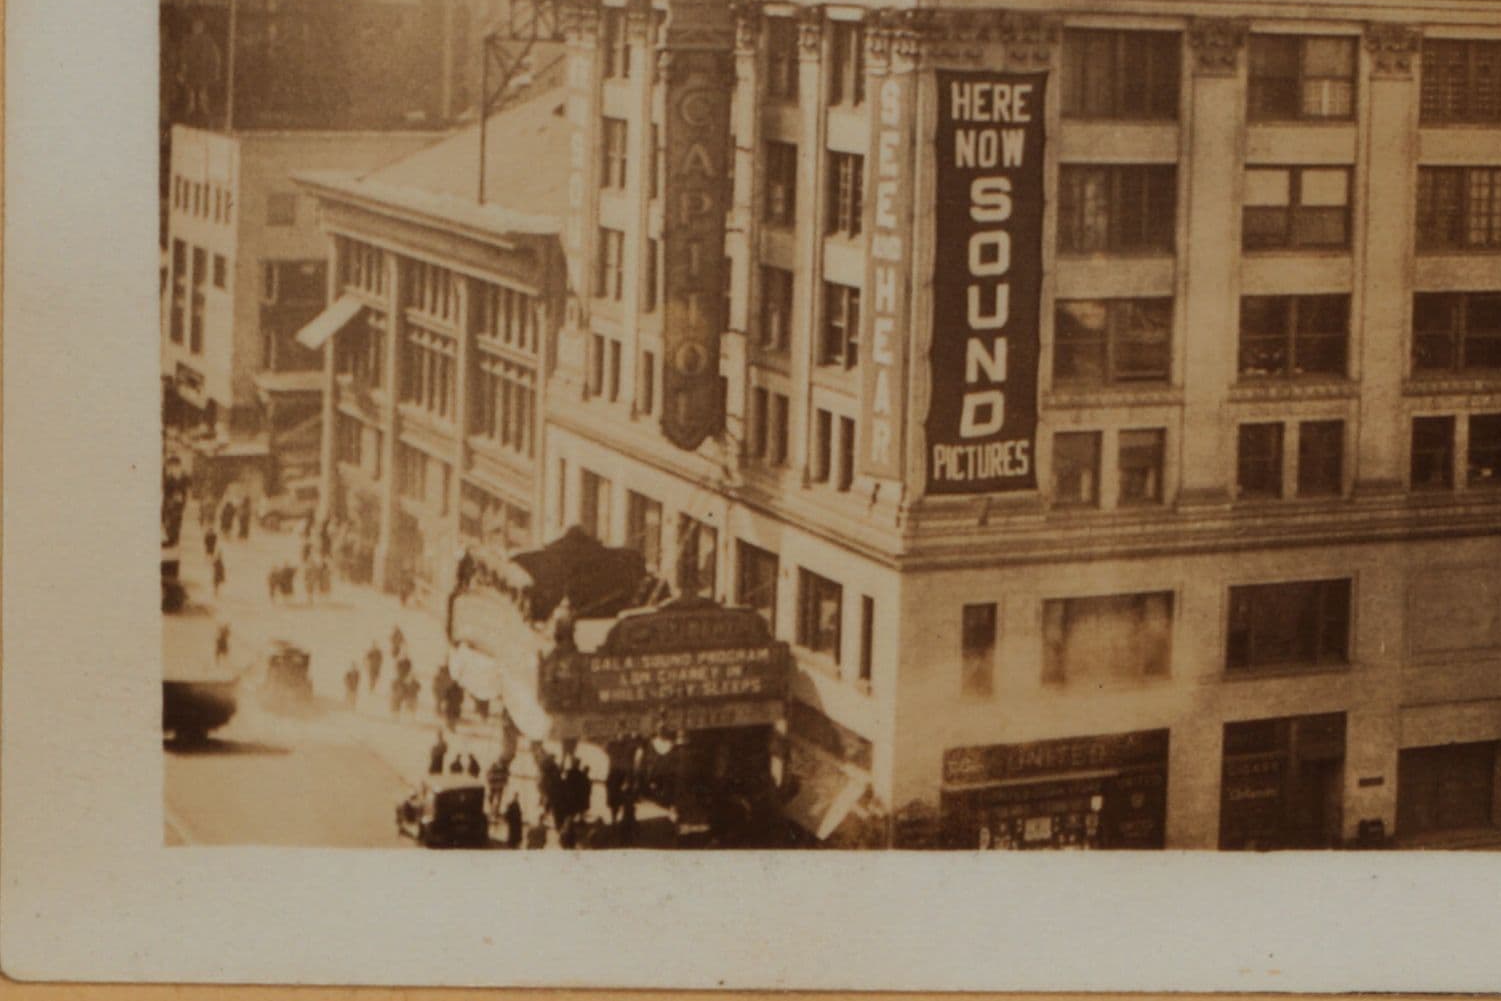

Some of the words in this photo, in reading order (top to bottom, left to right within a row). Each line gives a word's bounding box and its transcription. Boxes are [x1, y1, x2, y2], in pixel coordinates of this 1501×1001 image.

[951, 82, 1033, 122] HERE
[955, 129, 1025, 169] NOW
[959, 176, 1012, 439] SOUND
[933, 440, 1029, 482] PICTURES
[697, 647, 769, 665] PROGRAM
[726, 664, 743, 679] IN
